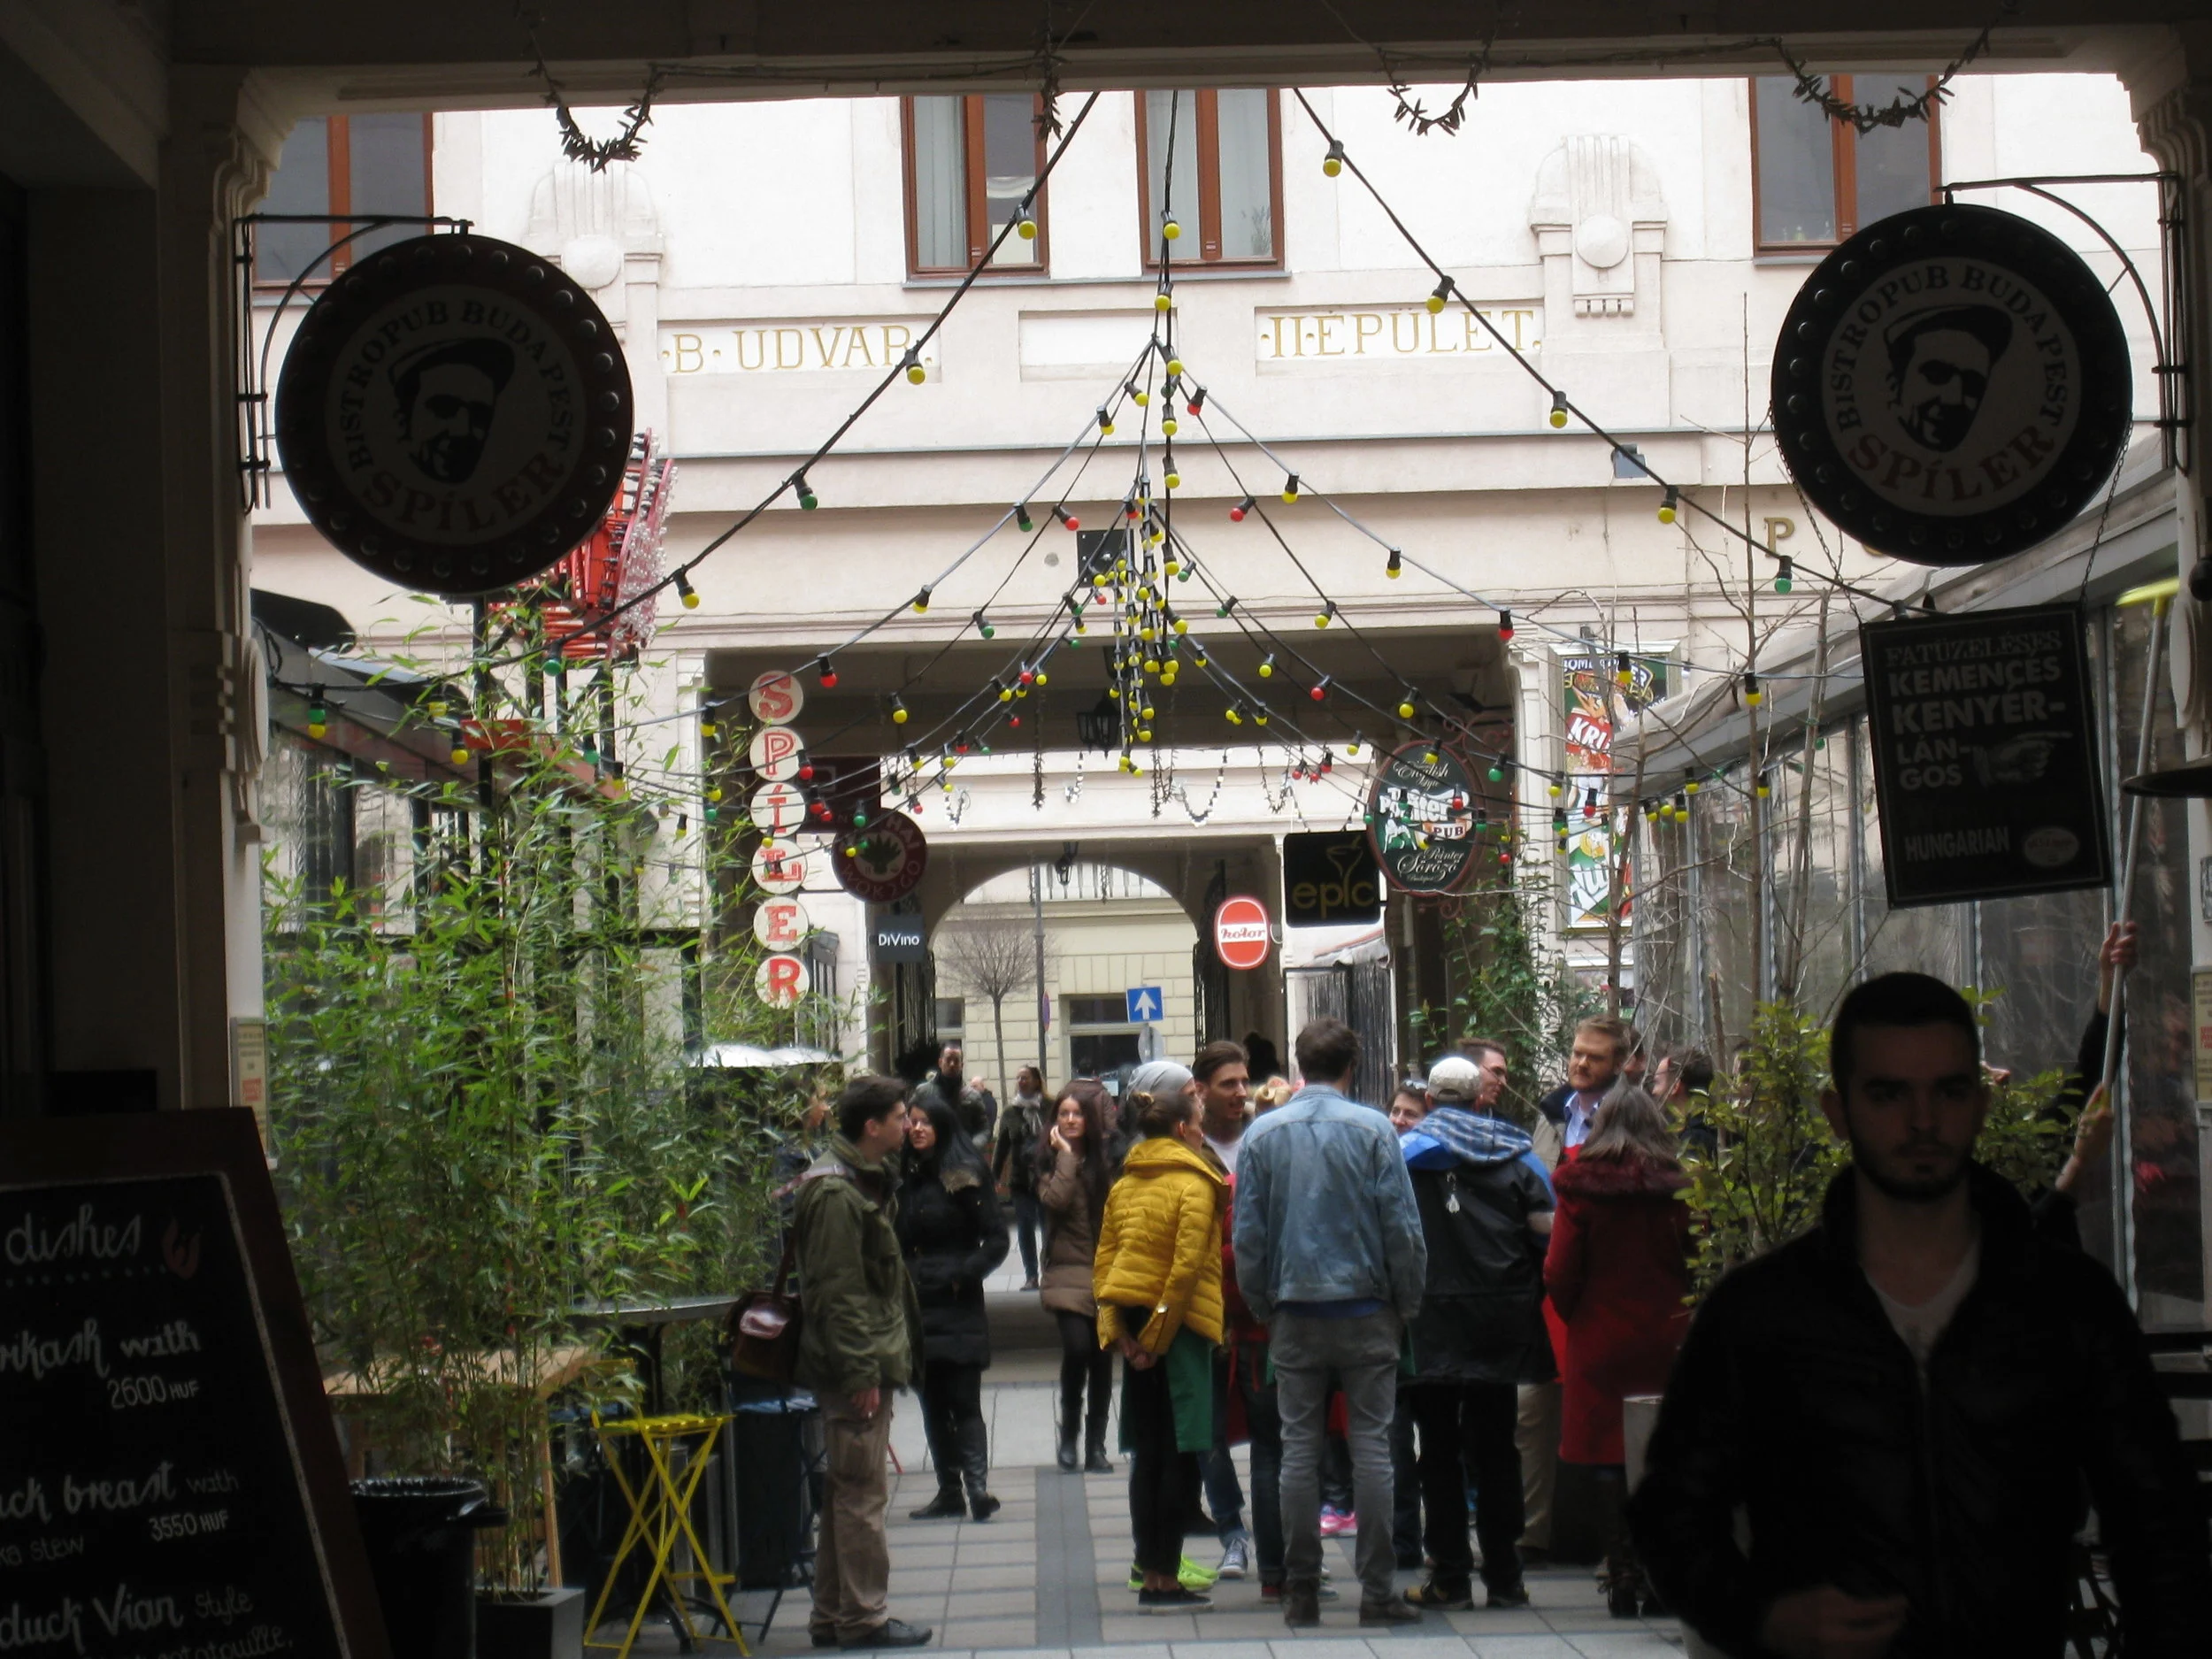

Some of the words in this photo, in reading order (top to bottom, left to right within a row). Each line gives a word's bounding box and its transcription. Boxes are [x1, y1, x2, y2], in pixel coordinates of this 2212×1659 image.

[1961, 265, 2068, 427] BUDAPEST
[1899, 764, 1963, 791] GOS
[1433, 826, 1464, 838] PUB
[1904, 826, 2011, 863] HUNGARIAN
[1292, 881, 1375, 920] epic
[5, 1202, 143, 1266] dishes
[119, 1320, 202, 1358] with
[106, 1374, 167, 1410] 2600
[168, 1379, 200, 1400] HUF
[62, 1460, 177, 1515] breast
[185, 1470, 240, 1494] with
[148, 1512, 197, 1542] 3550
[198, 1509, 231, 1532] HUF
[29, 1535, 85, 1562] stew
[0, 1597, 86, 1656] duck
